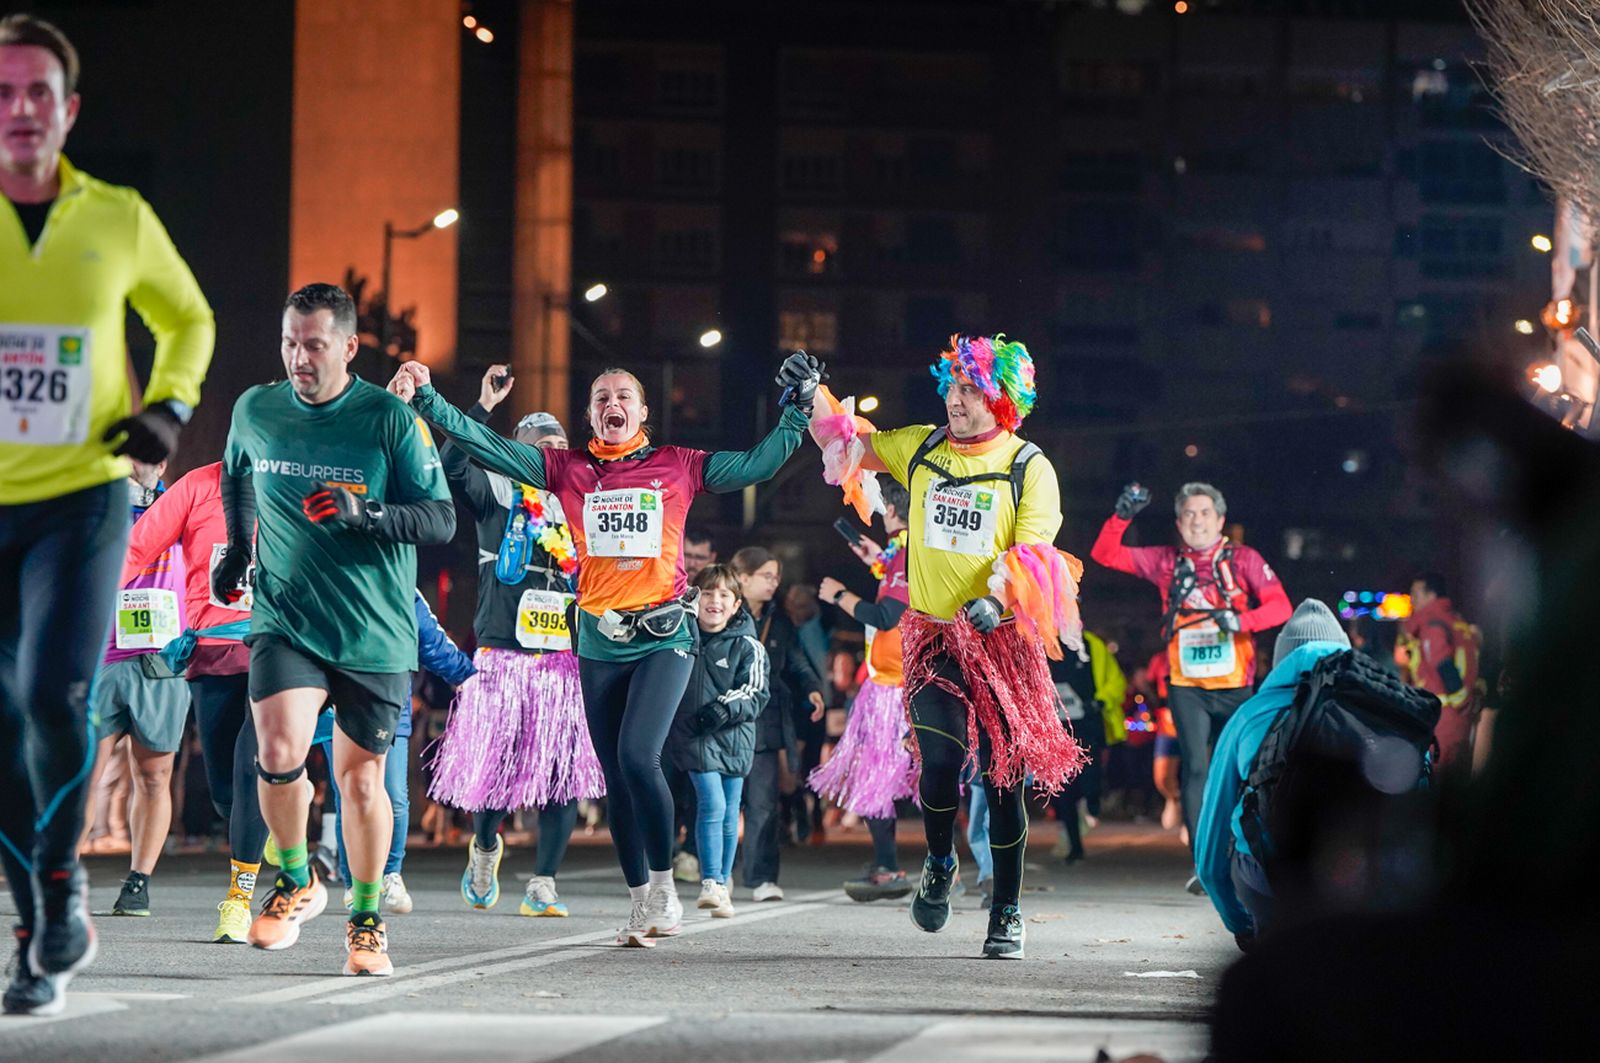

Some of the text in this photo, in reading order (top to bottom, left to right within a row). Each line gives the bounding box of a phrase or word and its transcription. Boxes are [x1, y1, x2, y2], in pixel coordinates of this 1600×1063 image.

[0, 368, 67, 403] 326
[254, 458, 364, 483] LOVEBURPEES
[932, 494, 946, 502] SAN
[598, 512, 648, 532] 3548
[933, 504, 982, 531] 3549
[529, 611, 567, 630] 3993
[1191, 645, 1222, 660] 7873
